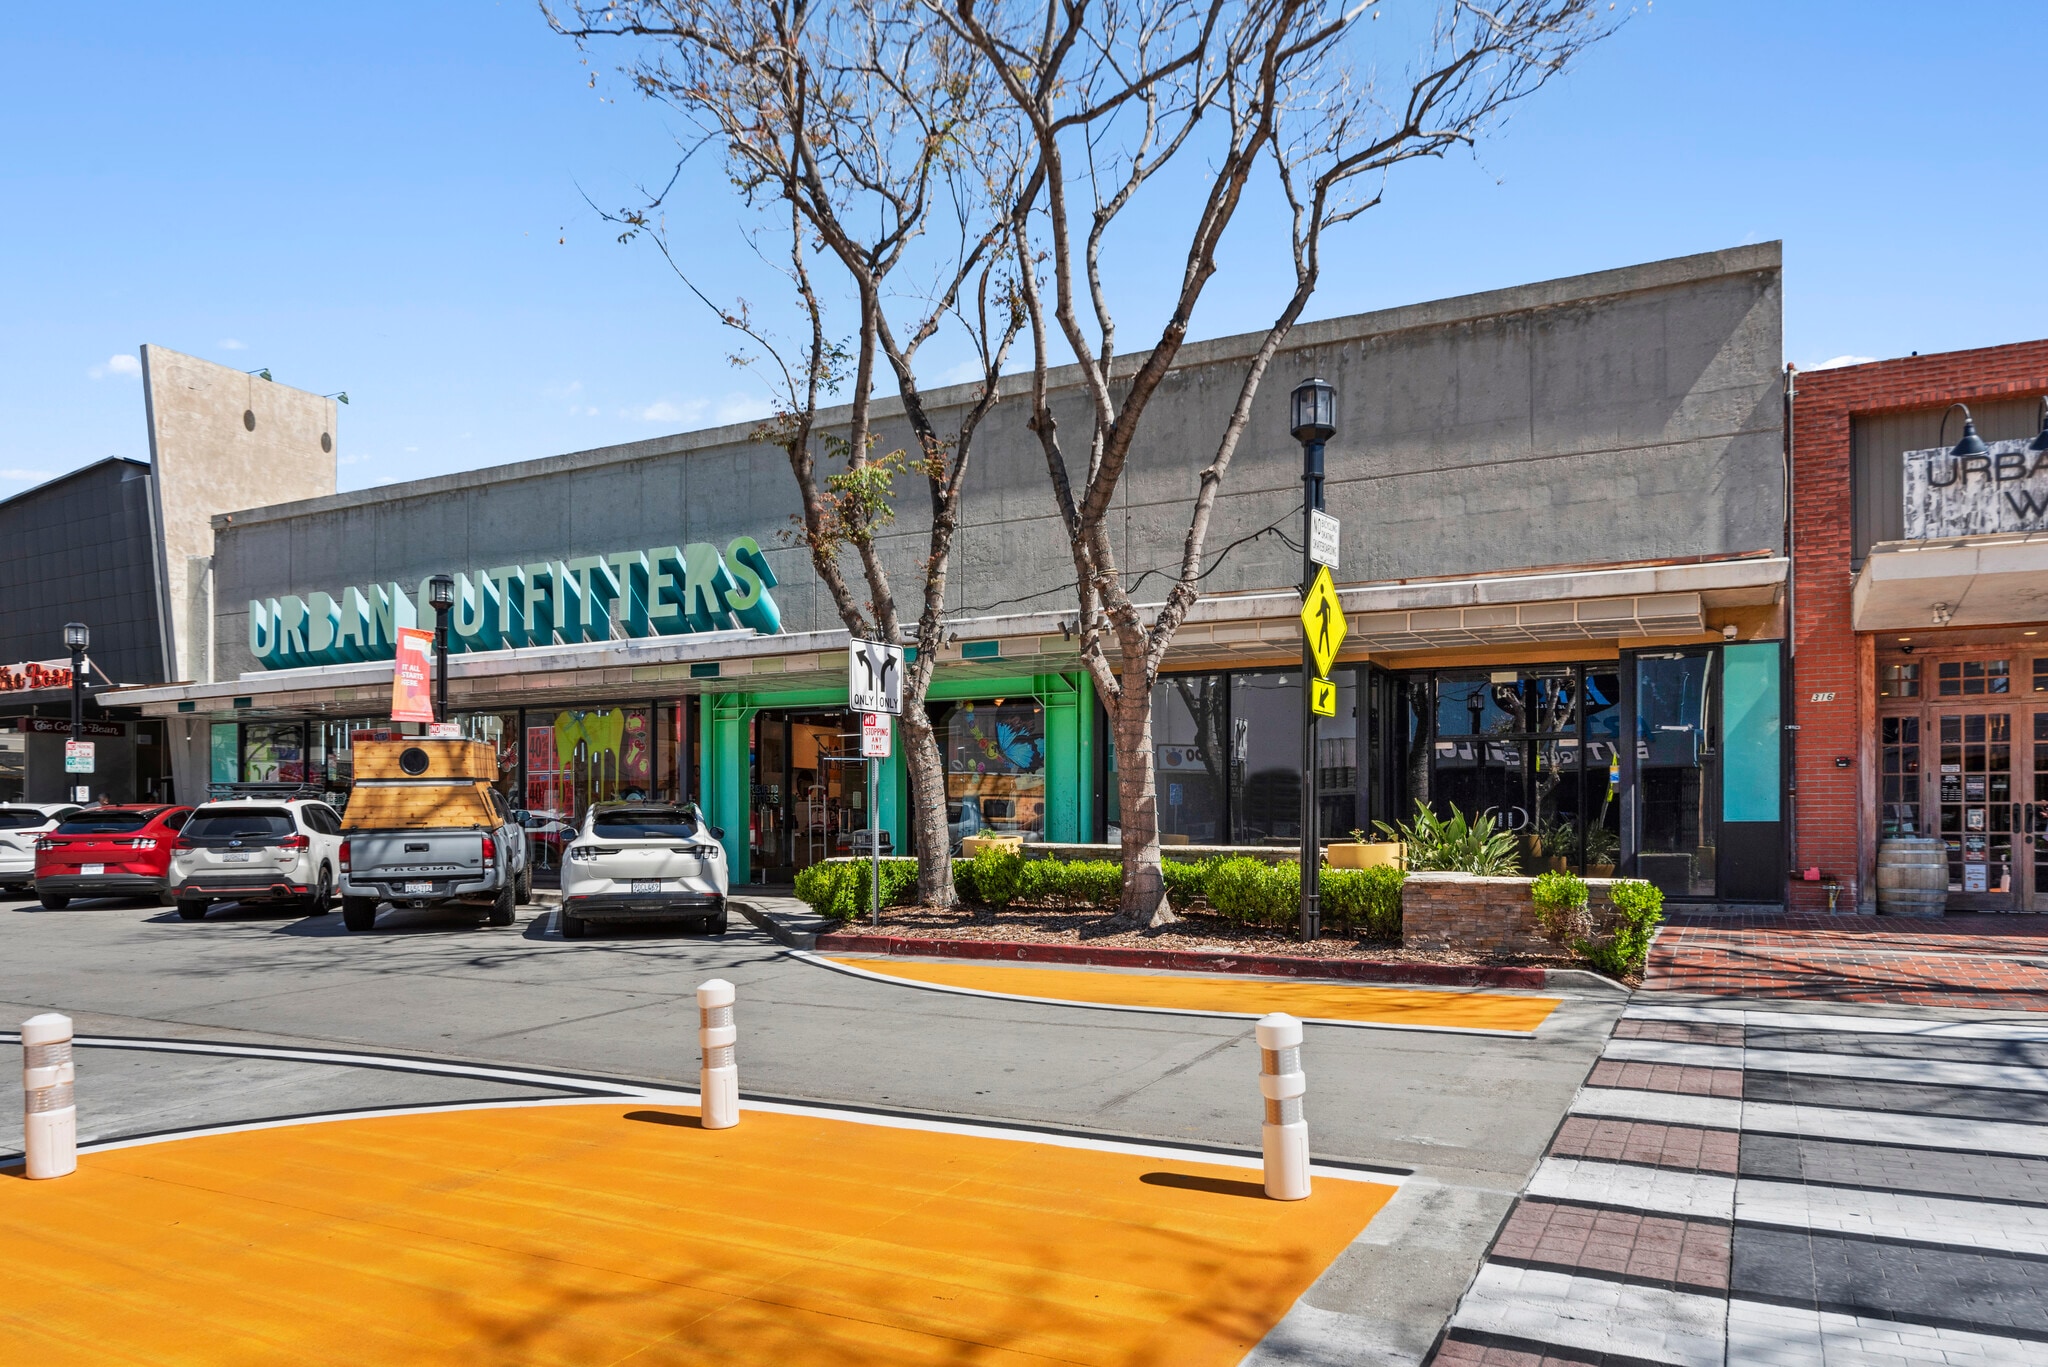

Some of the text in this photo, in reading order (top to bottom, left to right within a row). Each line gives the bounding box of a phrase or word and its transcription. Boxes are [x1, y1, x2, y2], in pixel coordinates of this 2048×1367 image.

[249, 581, 398, 658] URBAN
[402, 663, 421, 672] IT ALL
[401, 671, 424, 680] STARTS
[401, 678, 418, 687] HERE
[854, 693, 898, 708] ONLY ONLY
[1812, 692, 1833, 702] 316
[864, 714, 875, 725] NO
[33, 720, 52, 732] The
[88, 723, 119, 735] Bean
[430, 724, 440, 733] NO
[864, 727, 888, 737] STOPPING
